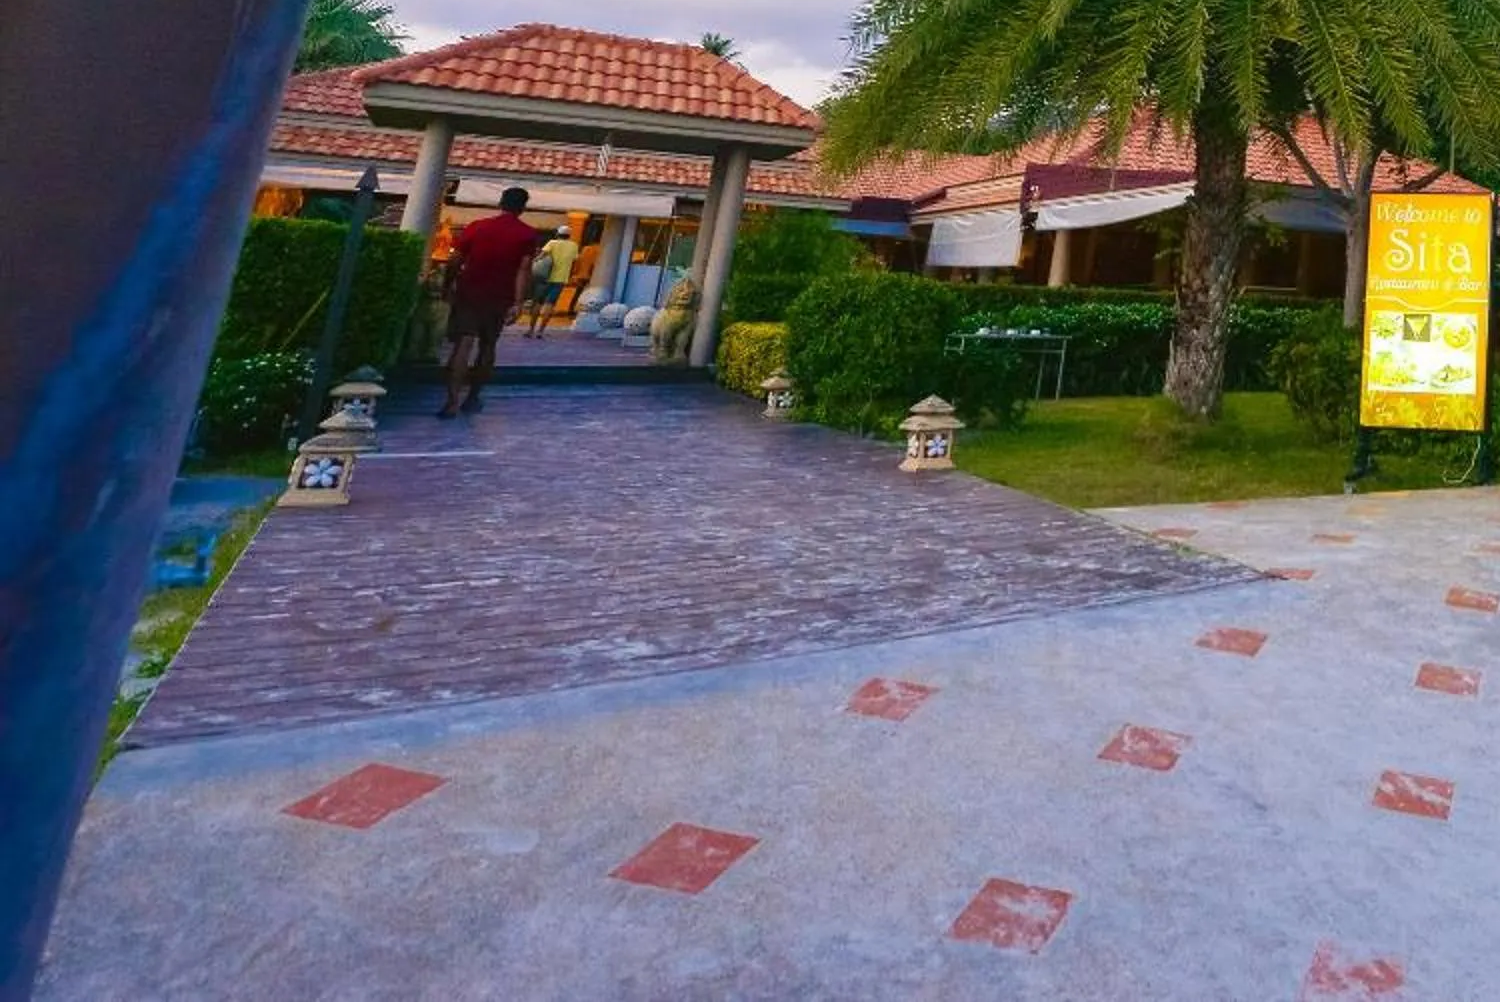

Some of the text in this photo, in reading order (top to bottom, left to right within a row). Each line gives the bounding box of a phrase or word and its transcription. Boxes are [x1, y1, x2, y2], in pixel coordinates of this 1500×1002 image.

[1376, 201, 1481, 224] Welcome to
[1385, 228, 1472, 273] Sita
